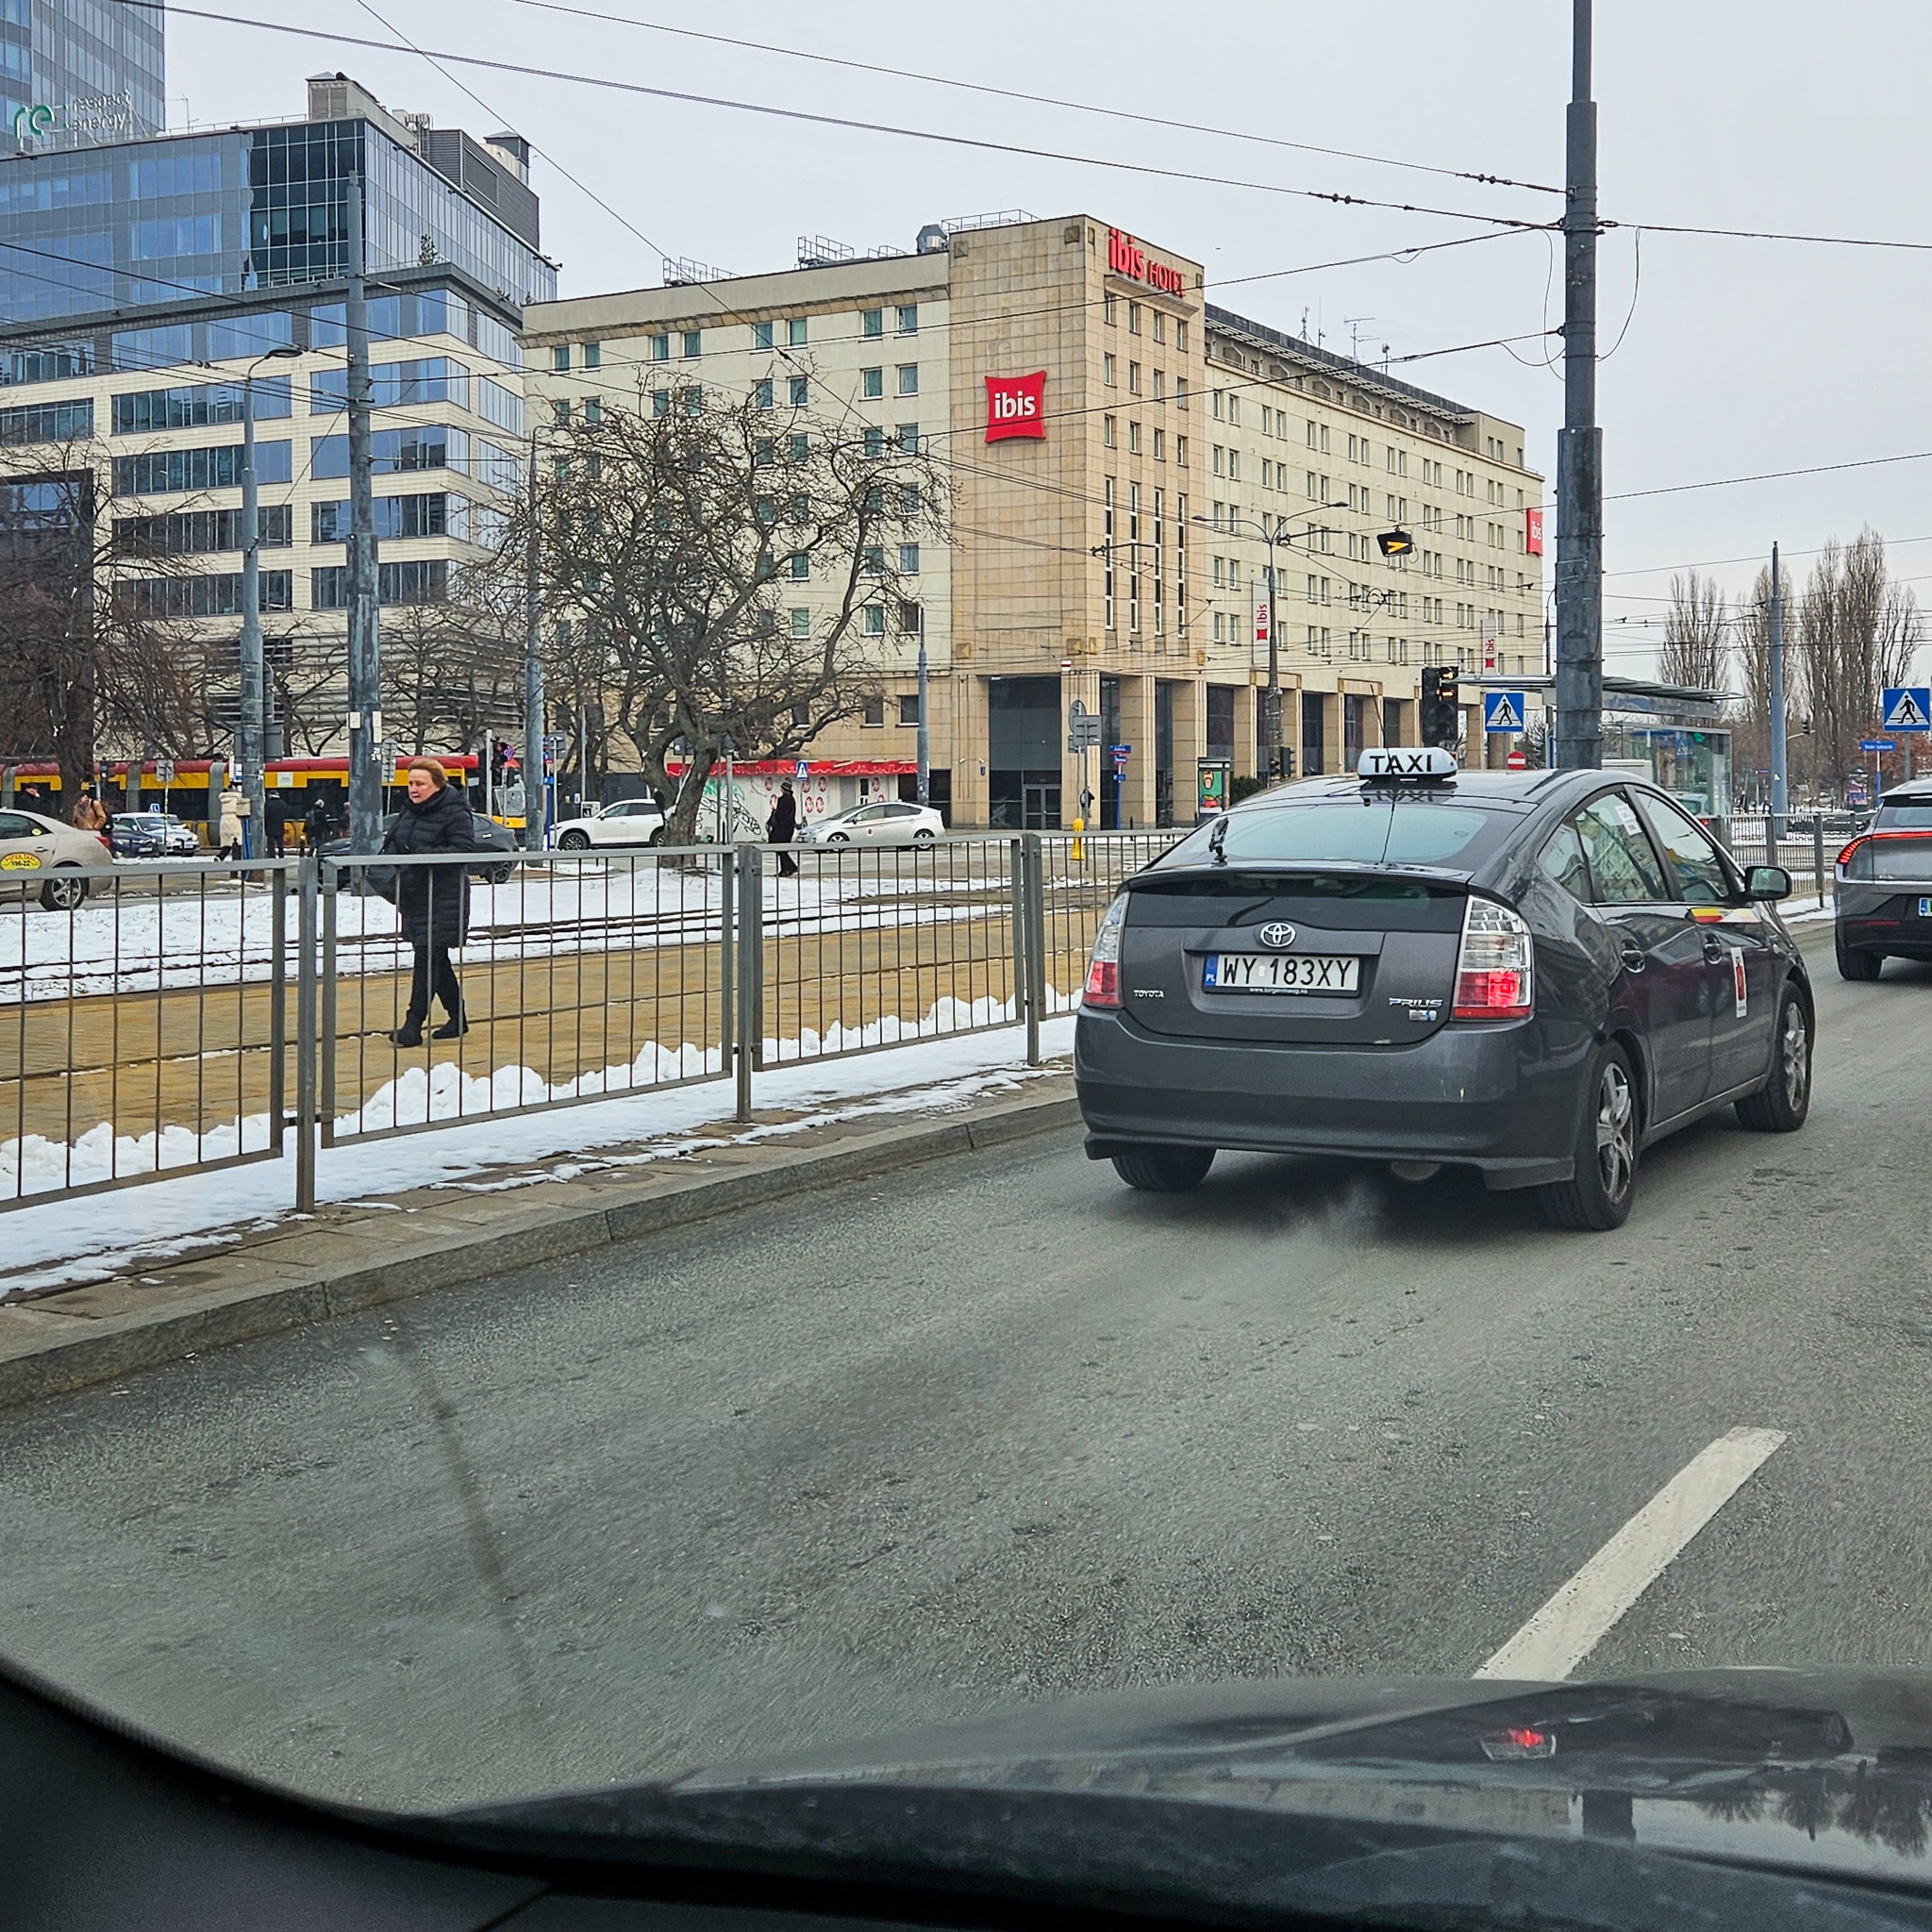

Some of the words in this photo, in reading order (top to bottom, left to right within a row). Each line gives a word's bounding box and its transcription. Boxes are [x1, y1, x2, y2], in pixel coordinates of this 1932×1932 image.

[73, 89, 131, 113] respect
[71, 112, 125, 132] energy
[1108, 227, 1144, 280] ibis
[1147, 259, 1183, 298] HOTEL
[994, 390, 1036, 419] ibis
[1257, 604, 1268, 624] ibis
[1485, 638, 1495, 655] ibis
[1369, 755, 1433, 774] TAXI
[1206, 974, 1216, 982] PL
[1224, 957, 1257, 984] WY
[1269, 958, 1353, 988] 183XY
[1133, 990, 1165, 998] TOYOTA
[1389, 997, 1443, 1008] PRIUS
